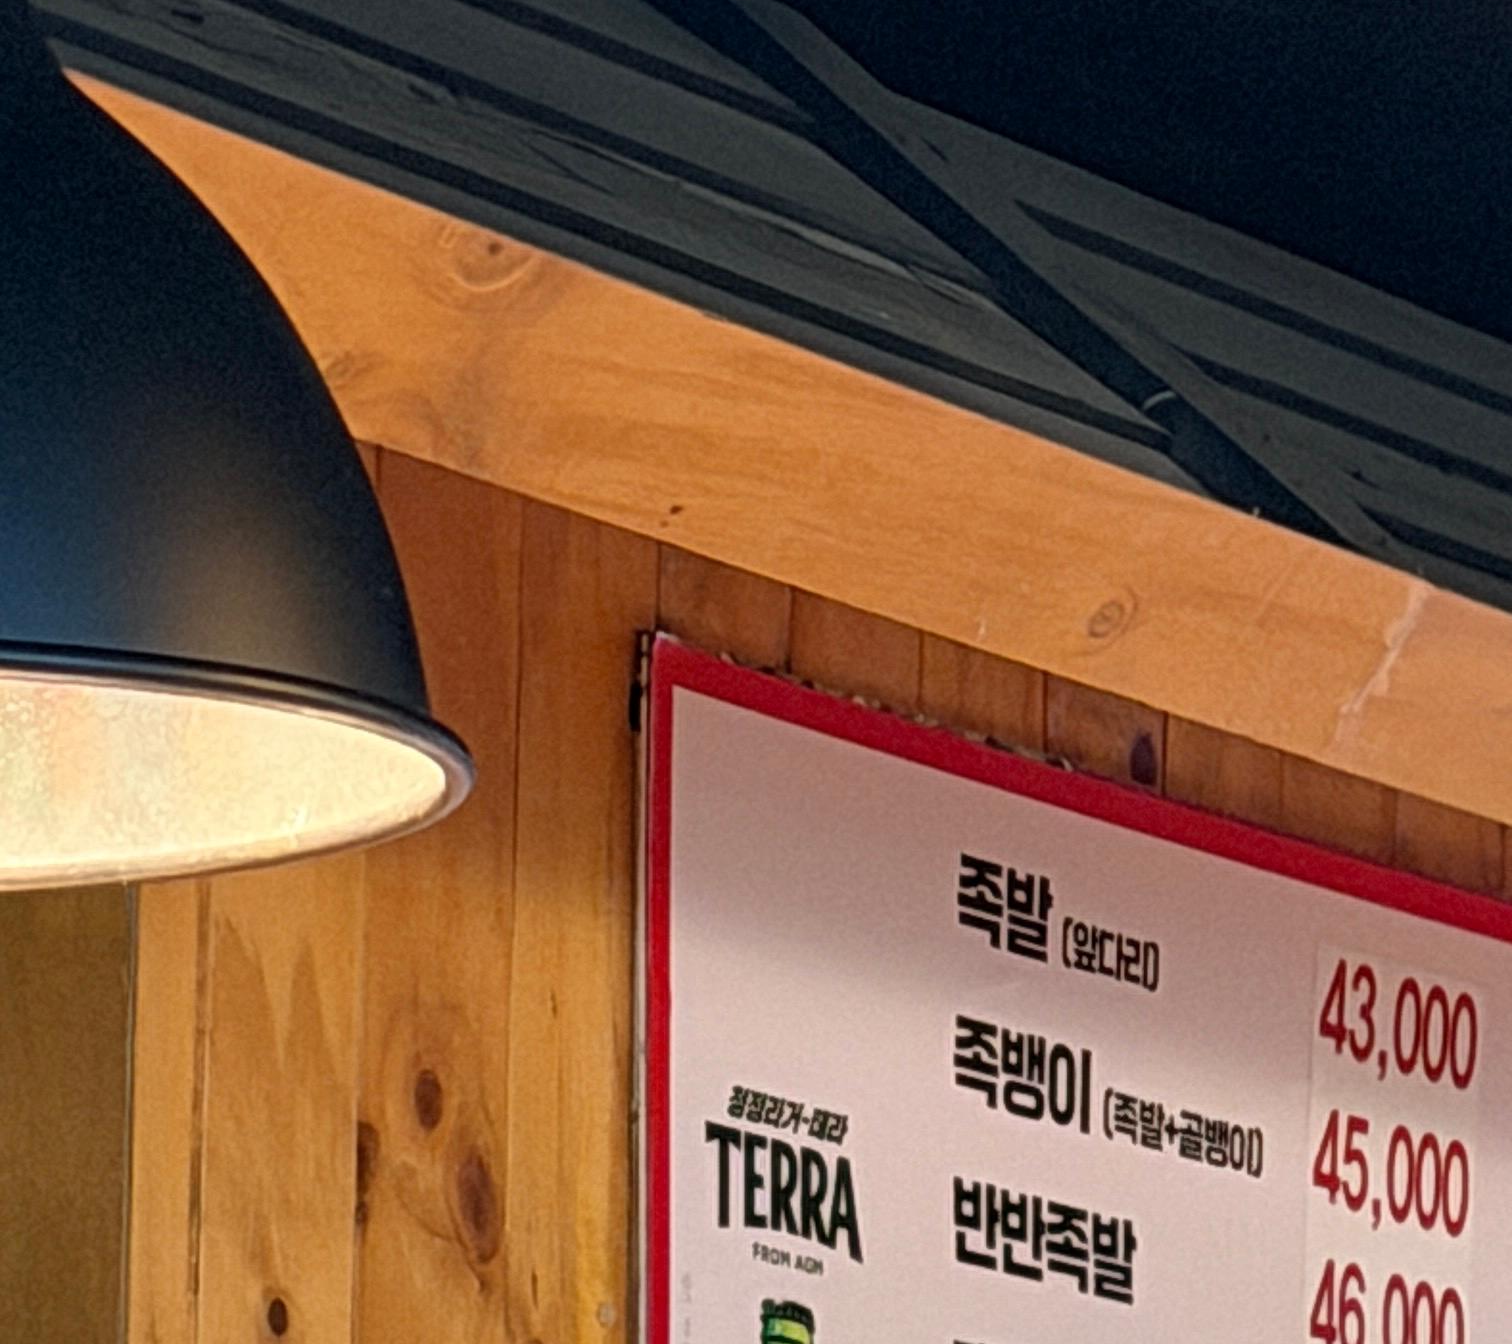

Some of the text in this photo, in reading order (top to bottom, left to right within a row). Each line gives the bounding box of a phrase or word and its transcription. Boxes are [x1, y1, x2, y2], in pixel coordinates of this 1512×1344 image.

[957, 852, 1160, 992] 족발 (앞다리)
[1319, 959, 1479, 1090] 43,000
[954, 1015, 1263, 1178] 족뱅이 (족발+골뱅이)
[705, 1120, 863, 1265] TERRA
[1312, 1109, 1470, 1236] 45,000
[952, 1177, 1137, 1305] 반반족발
